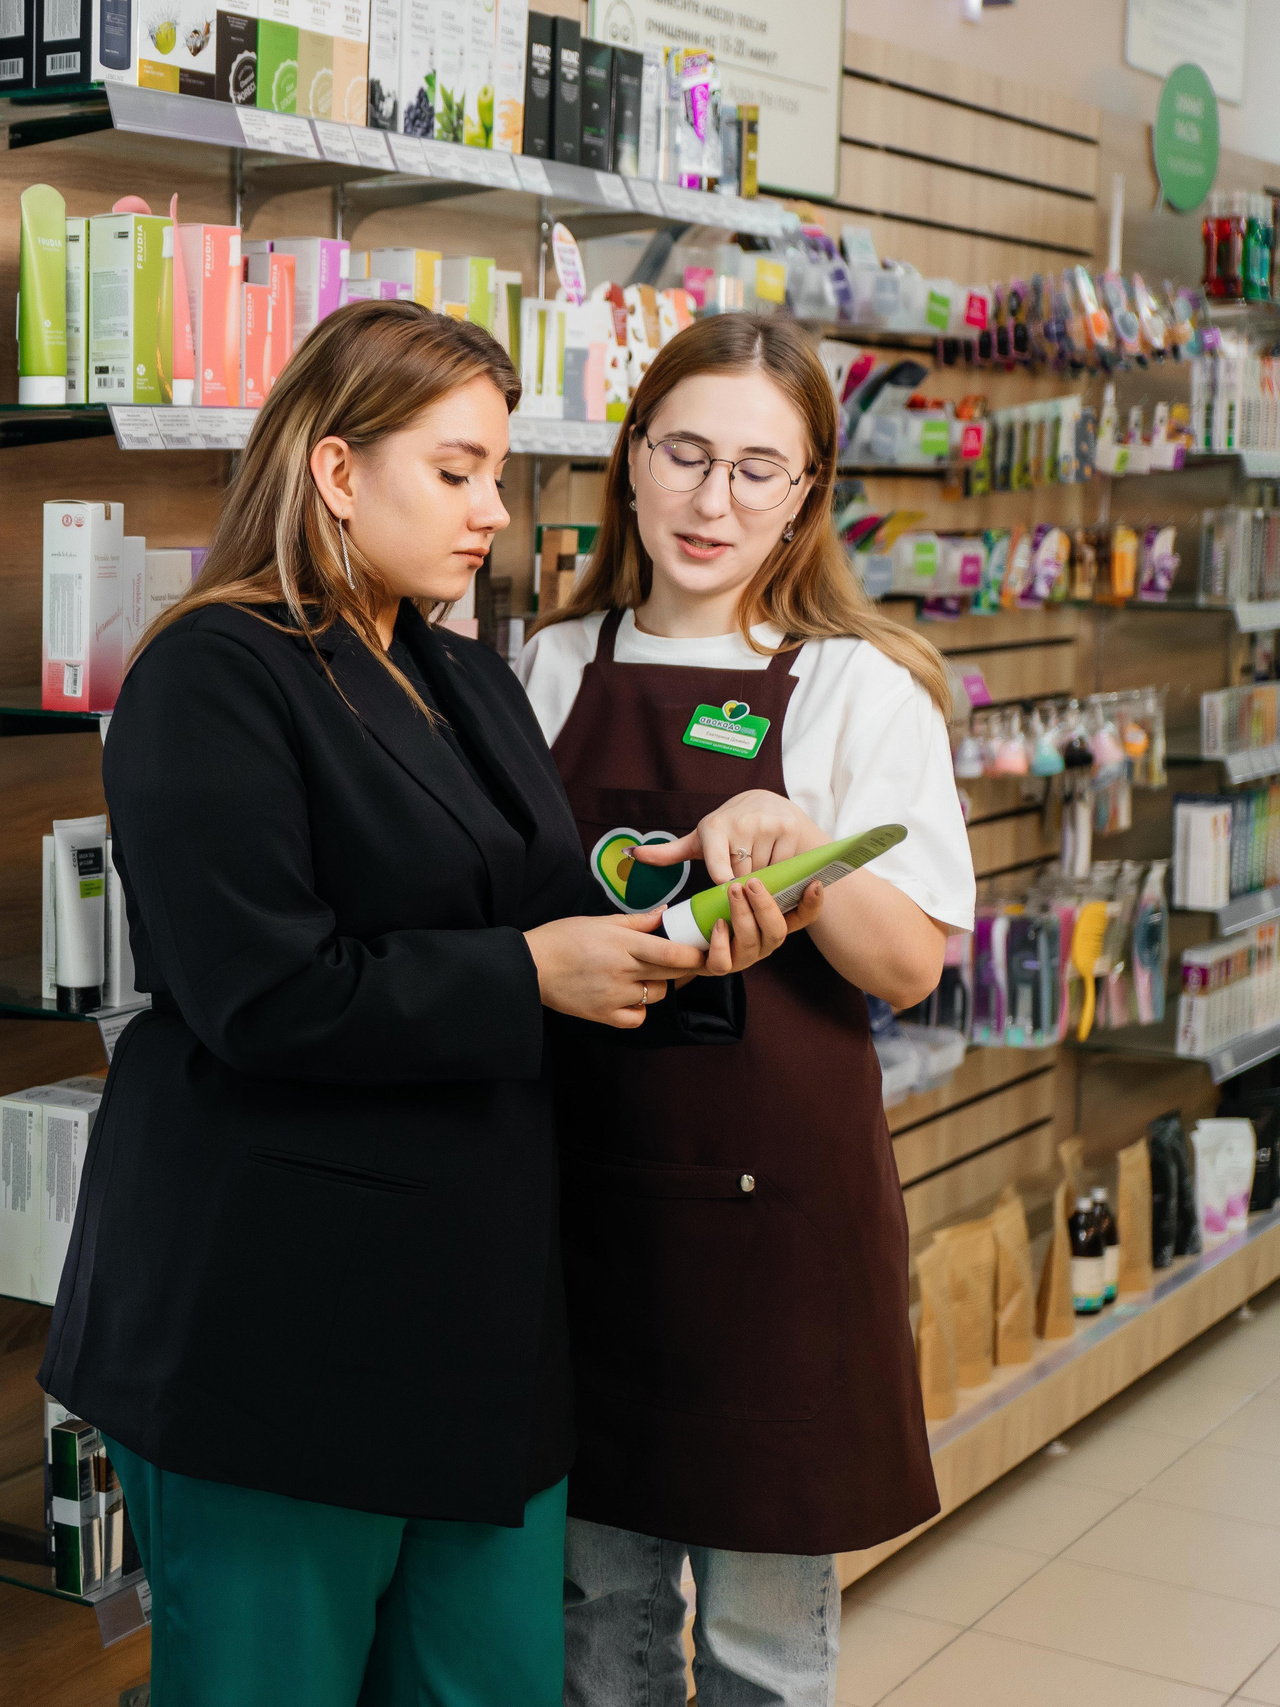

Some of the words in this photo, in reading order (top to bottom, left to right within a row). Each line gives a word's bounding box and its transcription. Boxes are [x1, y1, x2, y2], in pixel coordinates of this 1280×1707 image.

[37, 237, 62, 248] FRUDIA
[136, 224, 144, 269] FRUDIA
[700, 716, 741, 732] авокадо
